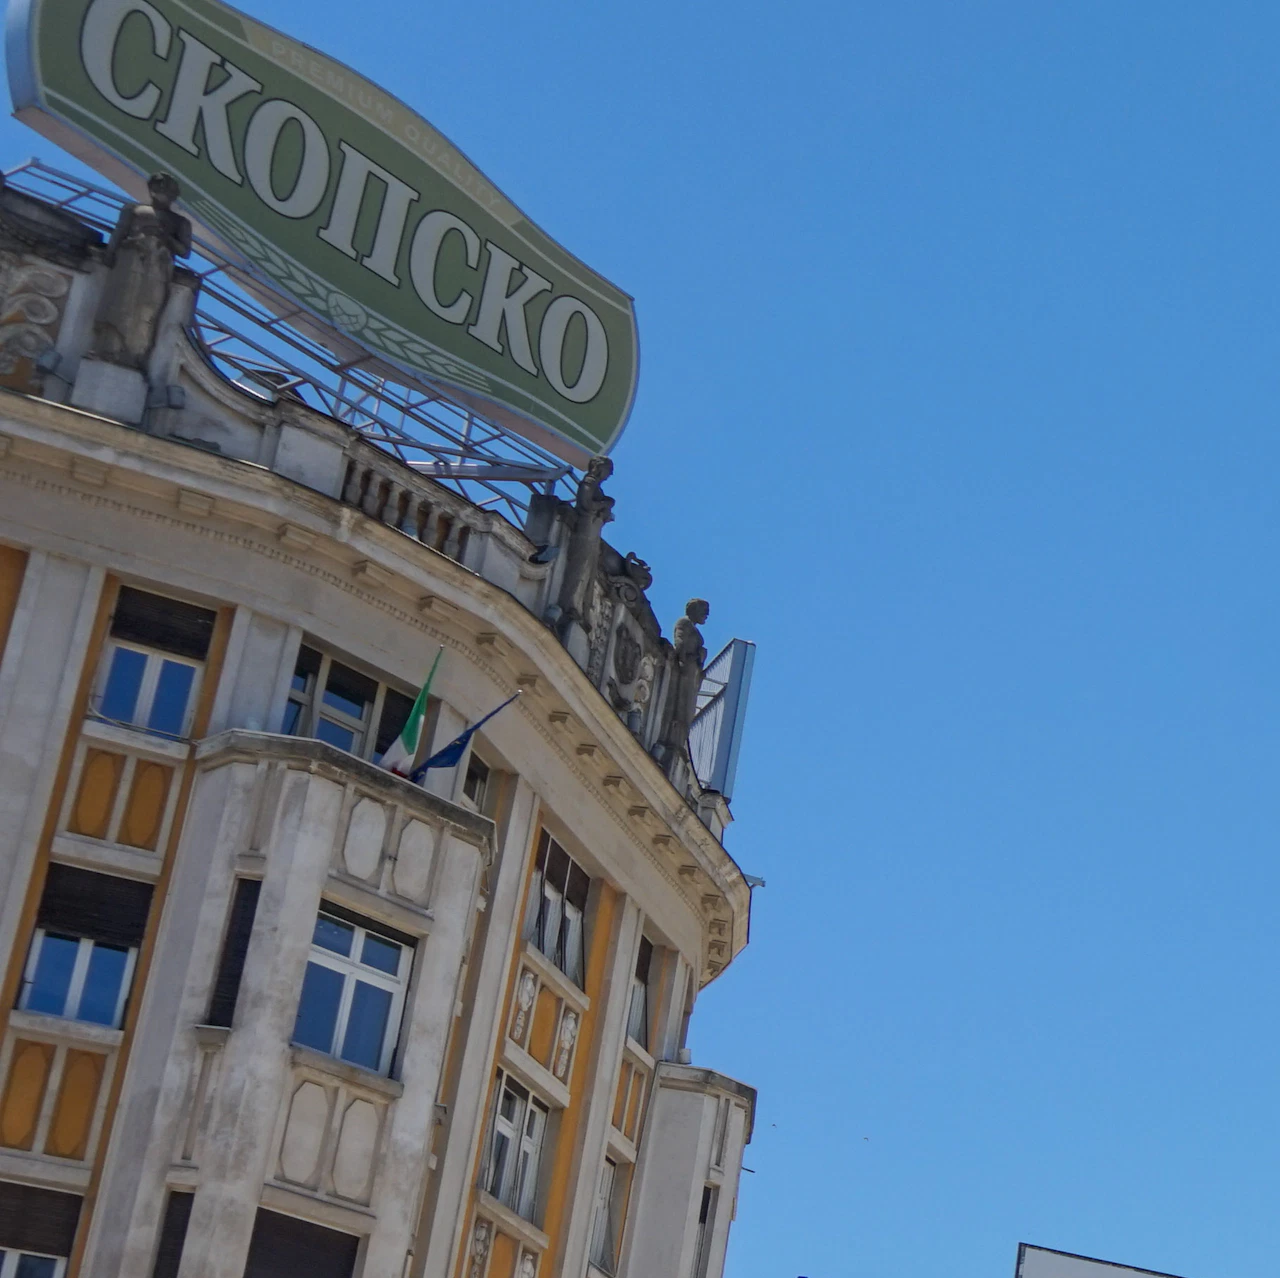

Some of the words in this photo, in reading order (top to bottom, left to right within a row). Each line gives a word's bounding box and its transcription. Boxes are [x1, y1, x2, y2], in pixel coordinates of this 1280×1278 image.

[79, 0, 610, 404] СКОПСКО
[271, 41, 394, 126] PREMIUM
[404, 124, 502, 207] QUALITY
